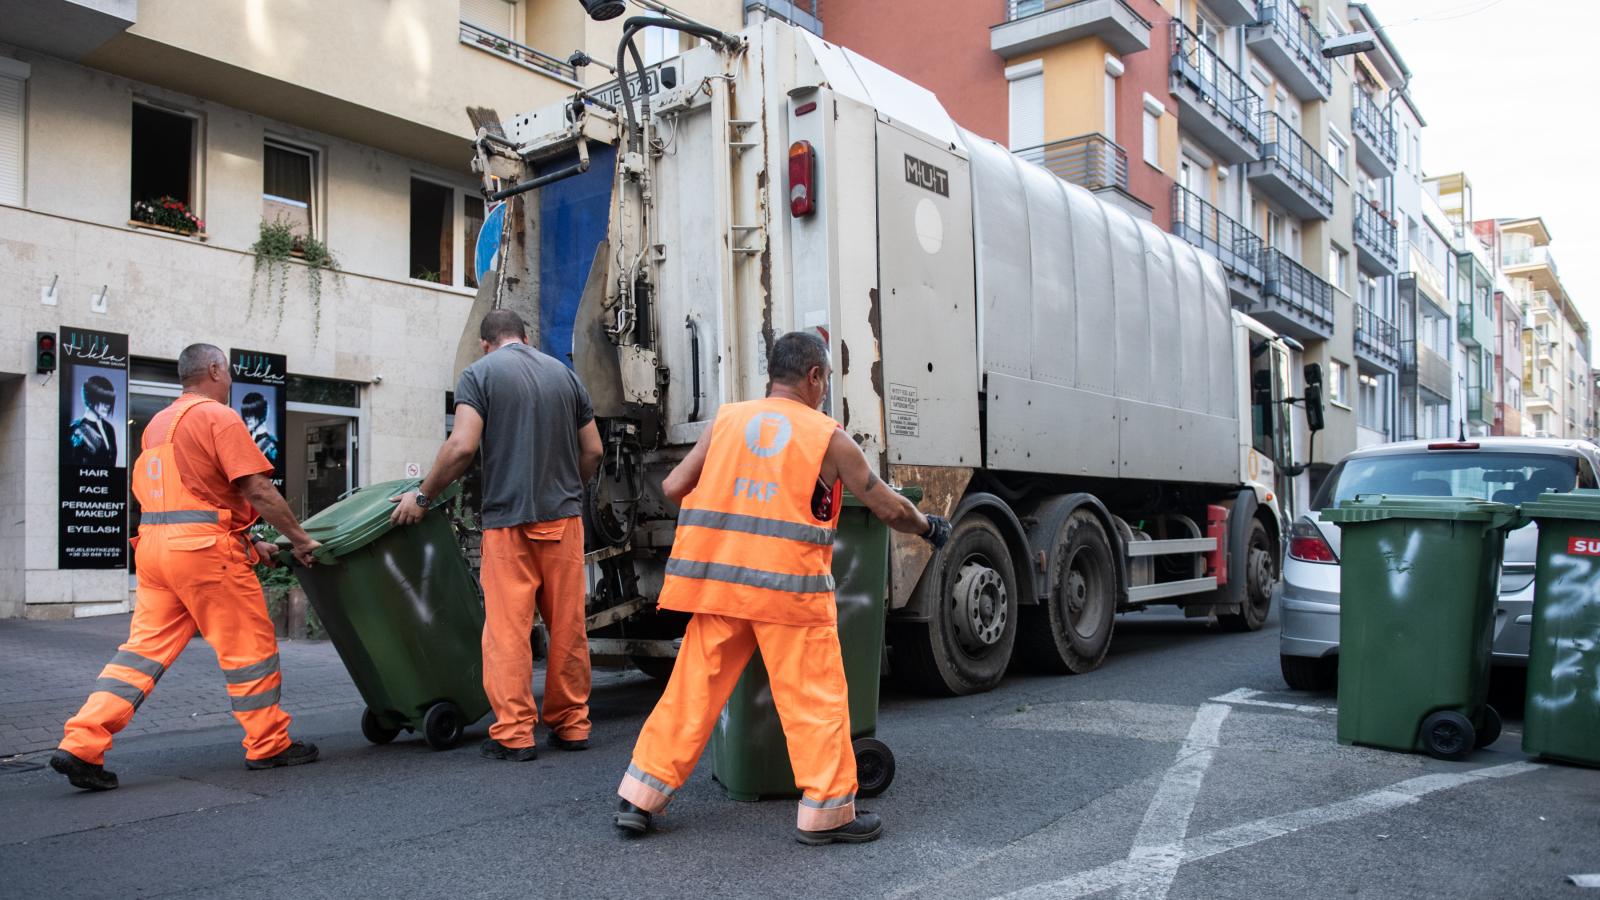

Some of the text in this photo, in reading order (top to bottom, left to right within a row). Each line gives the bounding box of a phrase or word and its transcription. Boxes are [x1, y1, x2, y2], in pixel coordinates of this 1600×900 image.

[79, 469, 109, 477] HAIR
[79, 486, 109, 494] FACE
[733, 477, 780, 503] FKF
[62, 501, 126, 510] PERMANENT
[75, 510, 119, 518] MAKEUP
[67, 525, 121, 533] EYELASH
